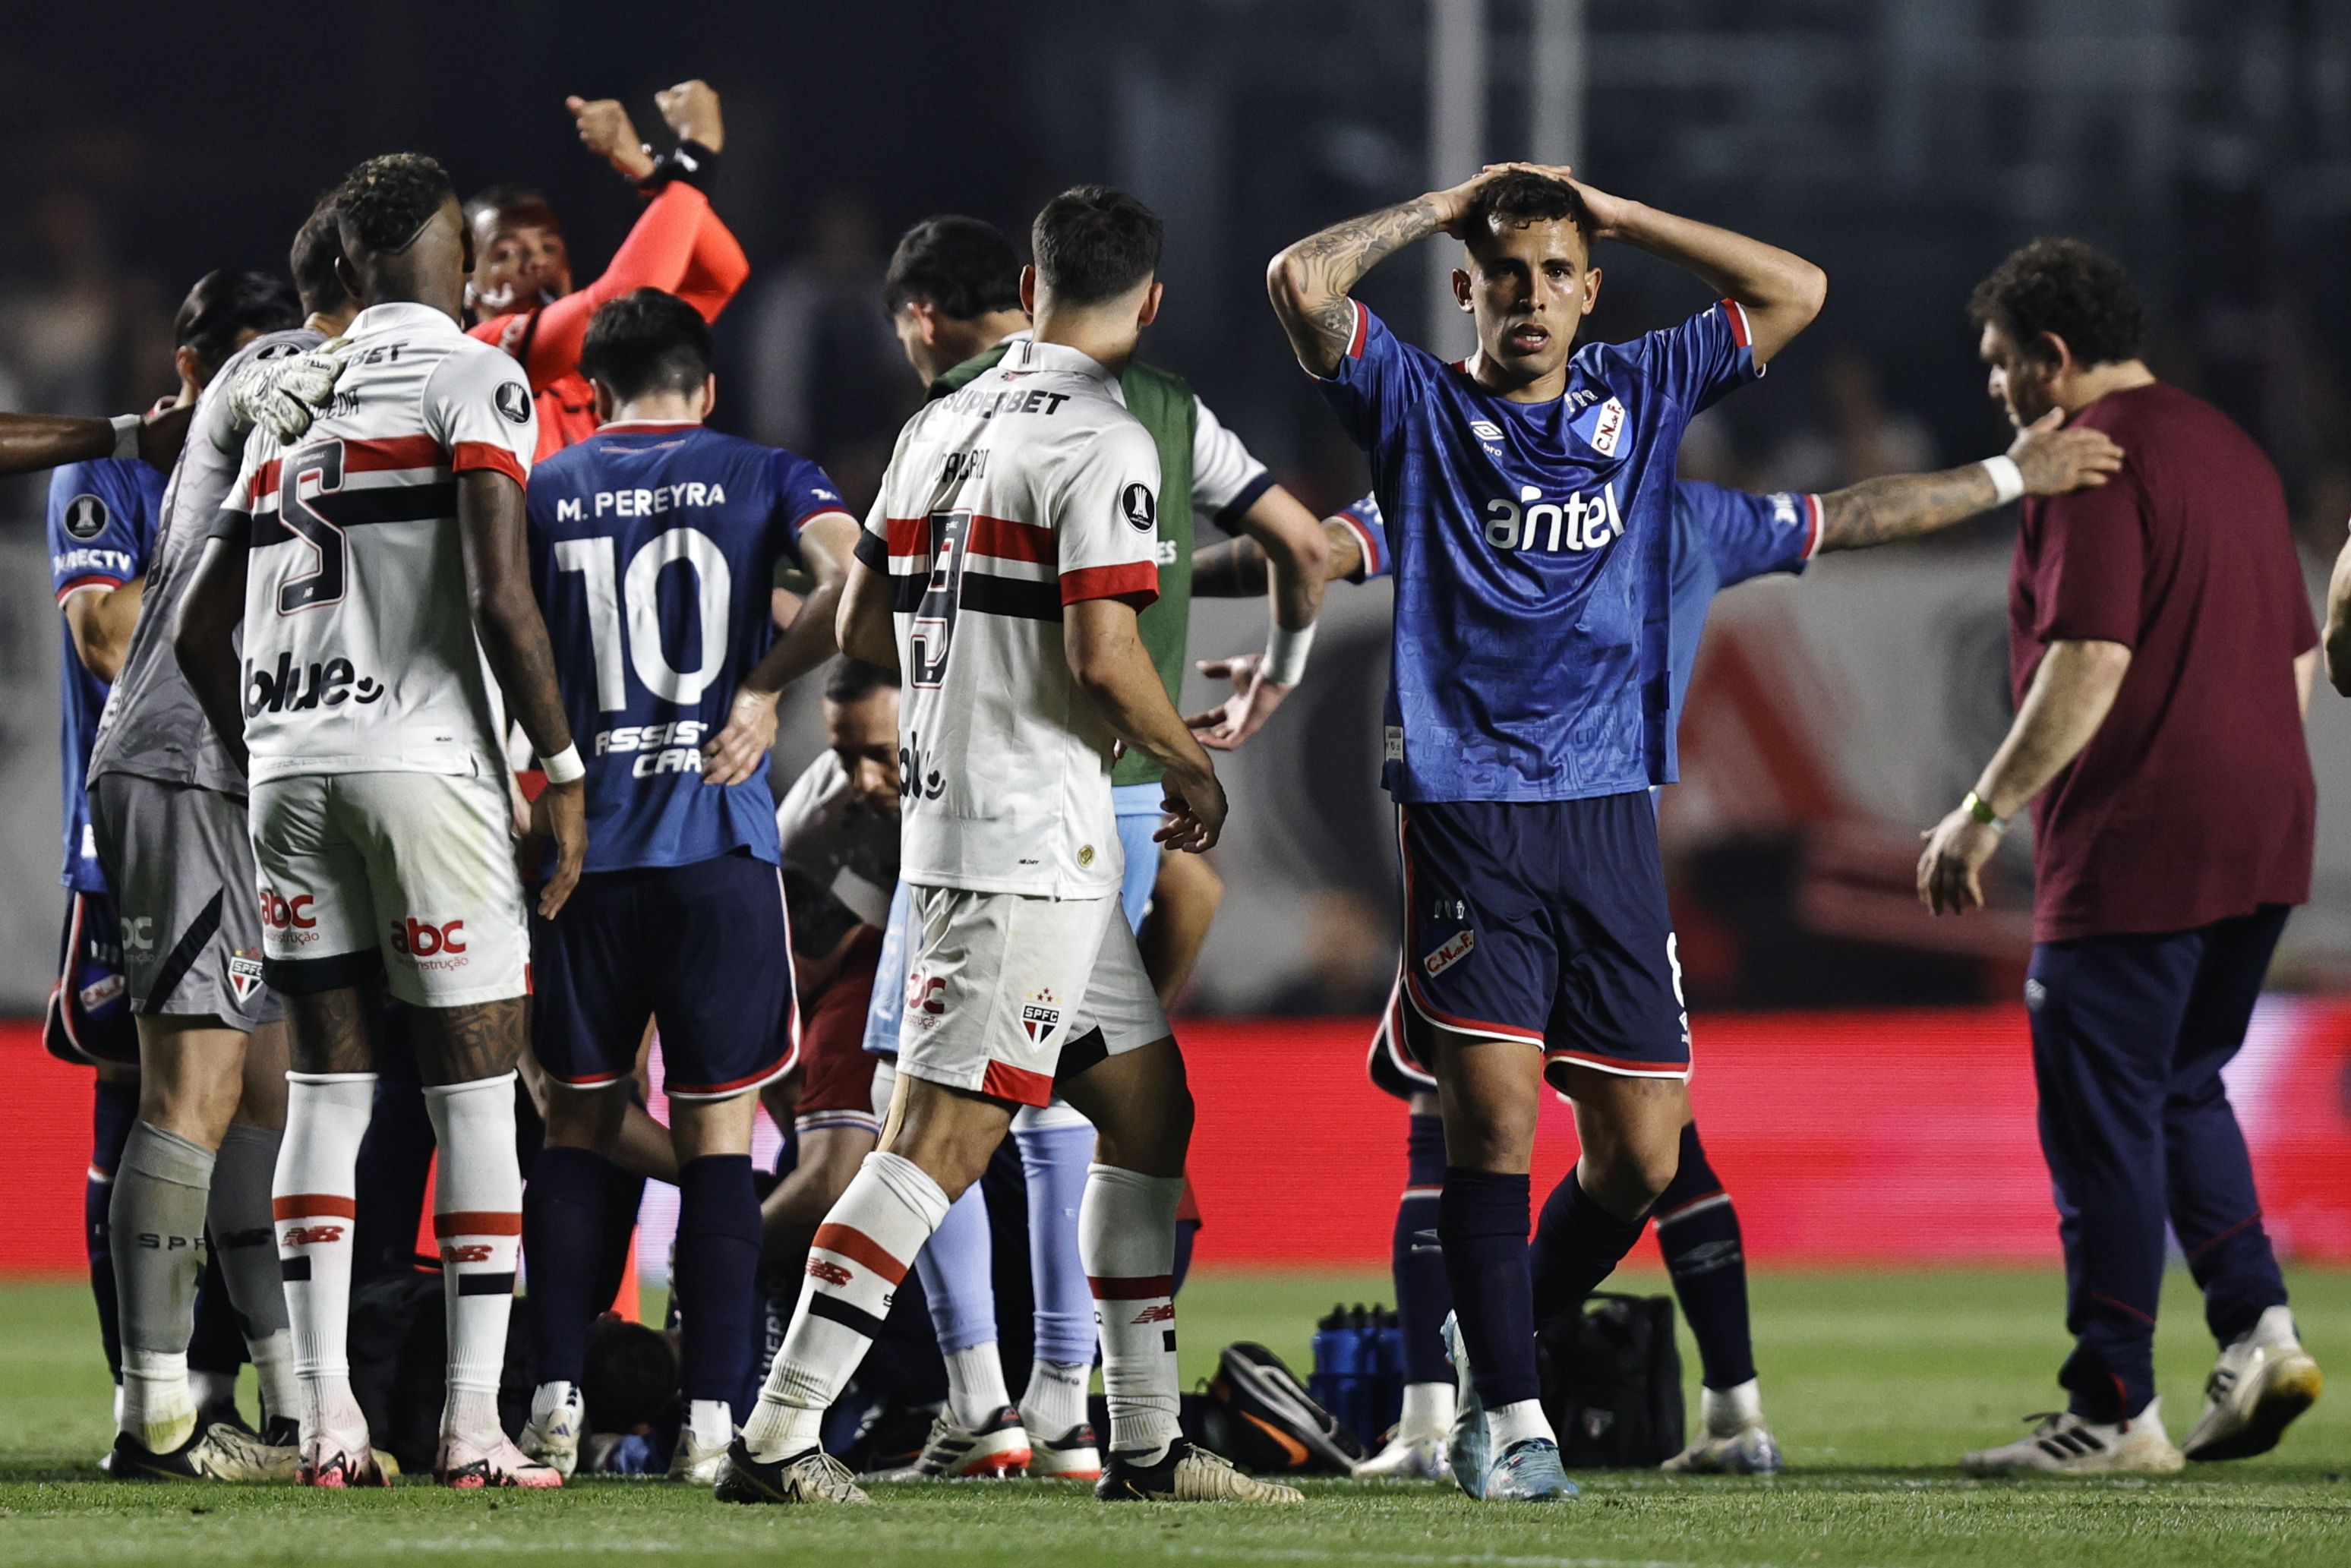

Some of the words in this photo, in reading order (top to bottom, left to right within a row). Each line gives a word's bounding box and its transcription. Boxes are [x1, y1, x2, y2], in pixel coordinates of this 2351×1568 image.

[942, 387, 1071, 419] SUPERBET
[1483, 441, 1502, 456] bro
[557, 498, 589, 523] M.
[595, 481, 726, 519] PEREYRA
[1485, 484, 1625, 553] antel
[276, 435, 349, 617] 5
[911, 508, 973, 689] 9
[554, 527, 732, 714] 10
[245, 651, 355, 719] blue
[595, 720, 708, 756] ASSIS
[632, 748, 703, 779] CAR
[260, 887, 317, 929] abc
[390, 917, 467, 957] abc
[1024, 1007, 1059, 1023] SPFC
